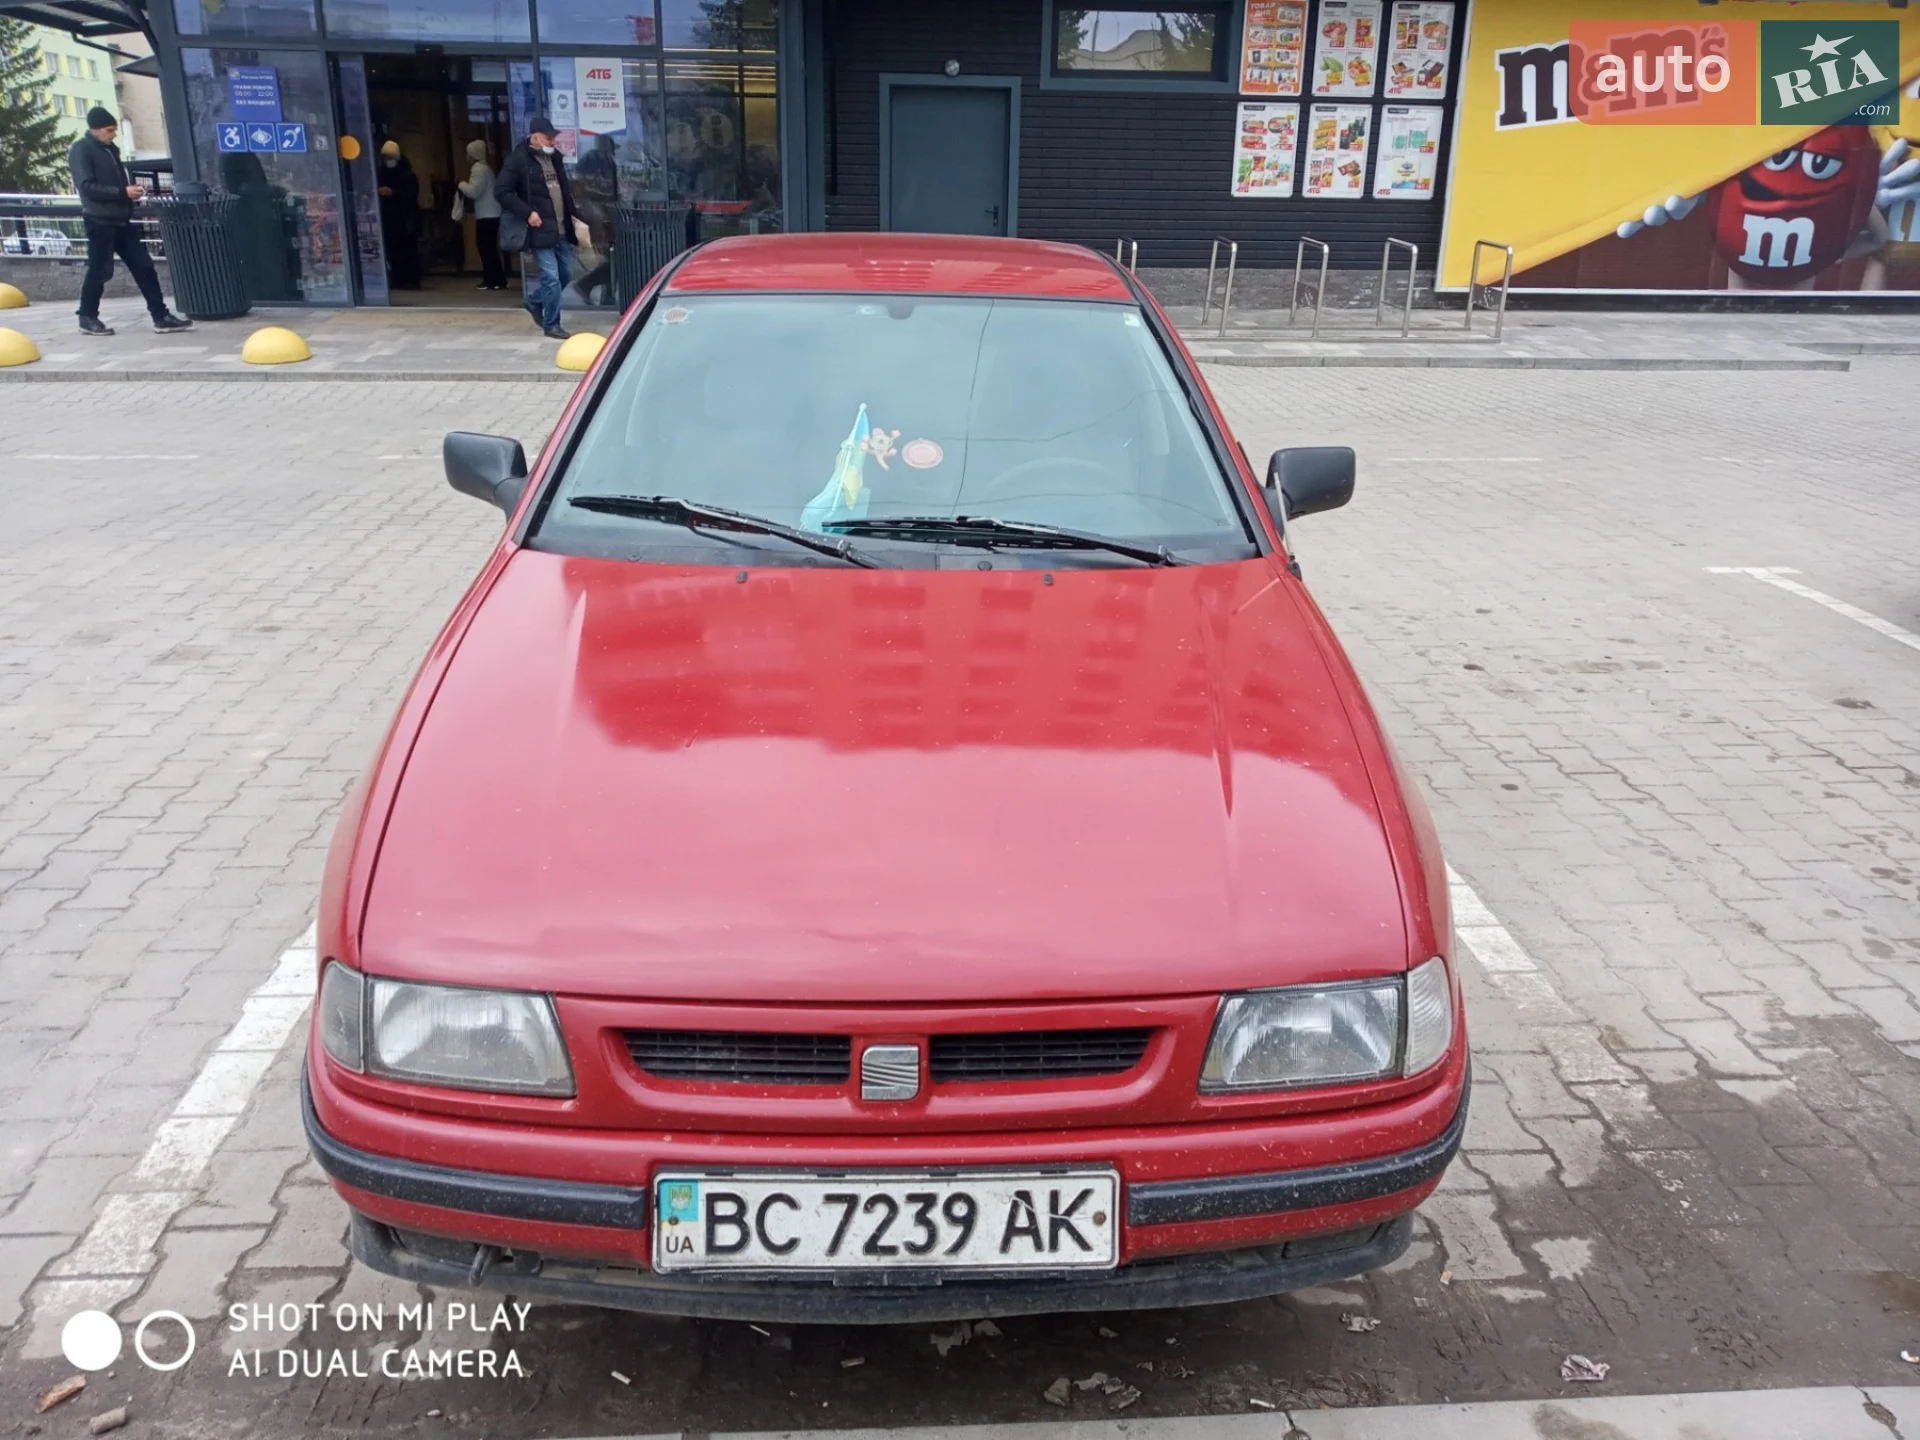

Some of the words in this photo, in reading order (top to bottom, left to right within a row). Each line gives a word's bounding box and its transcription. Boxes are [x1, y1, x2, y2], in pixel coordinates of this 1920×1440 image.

[1739, 213, 1815, 268] m
[665, 1235, 694, 1254] UA
[704, 1192, 801, 1256] BC
[822, 1190, 979, 1256] 7239
[1000, 1188, 1096, 1254] AK
